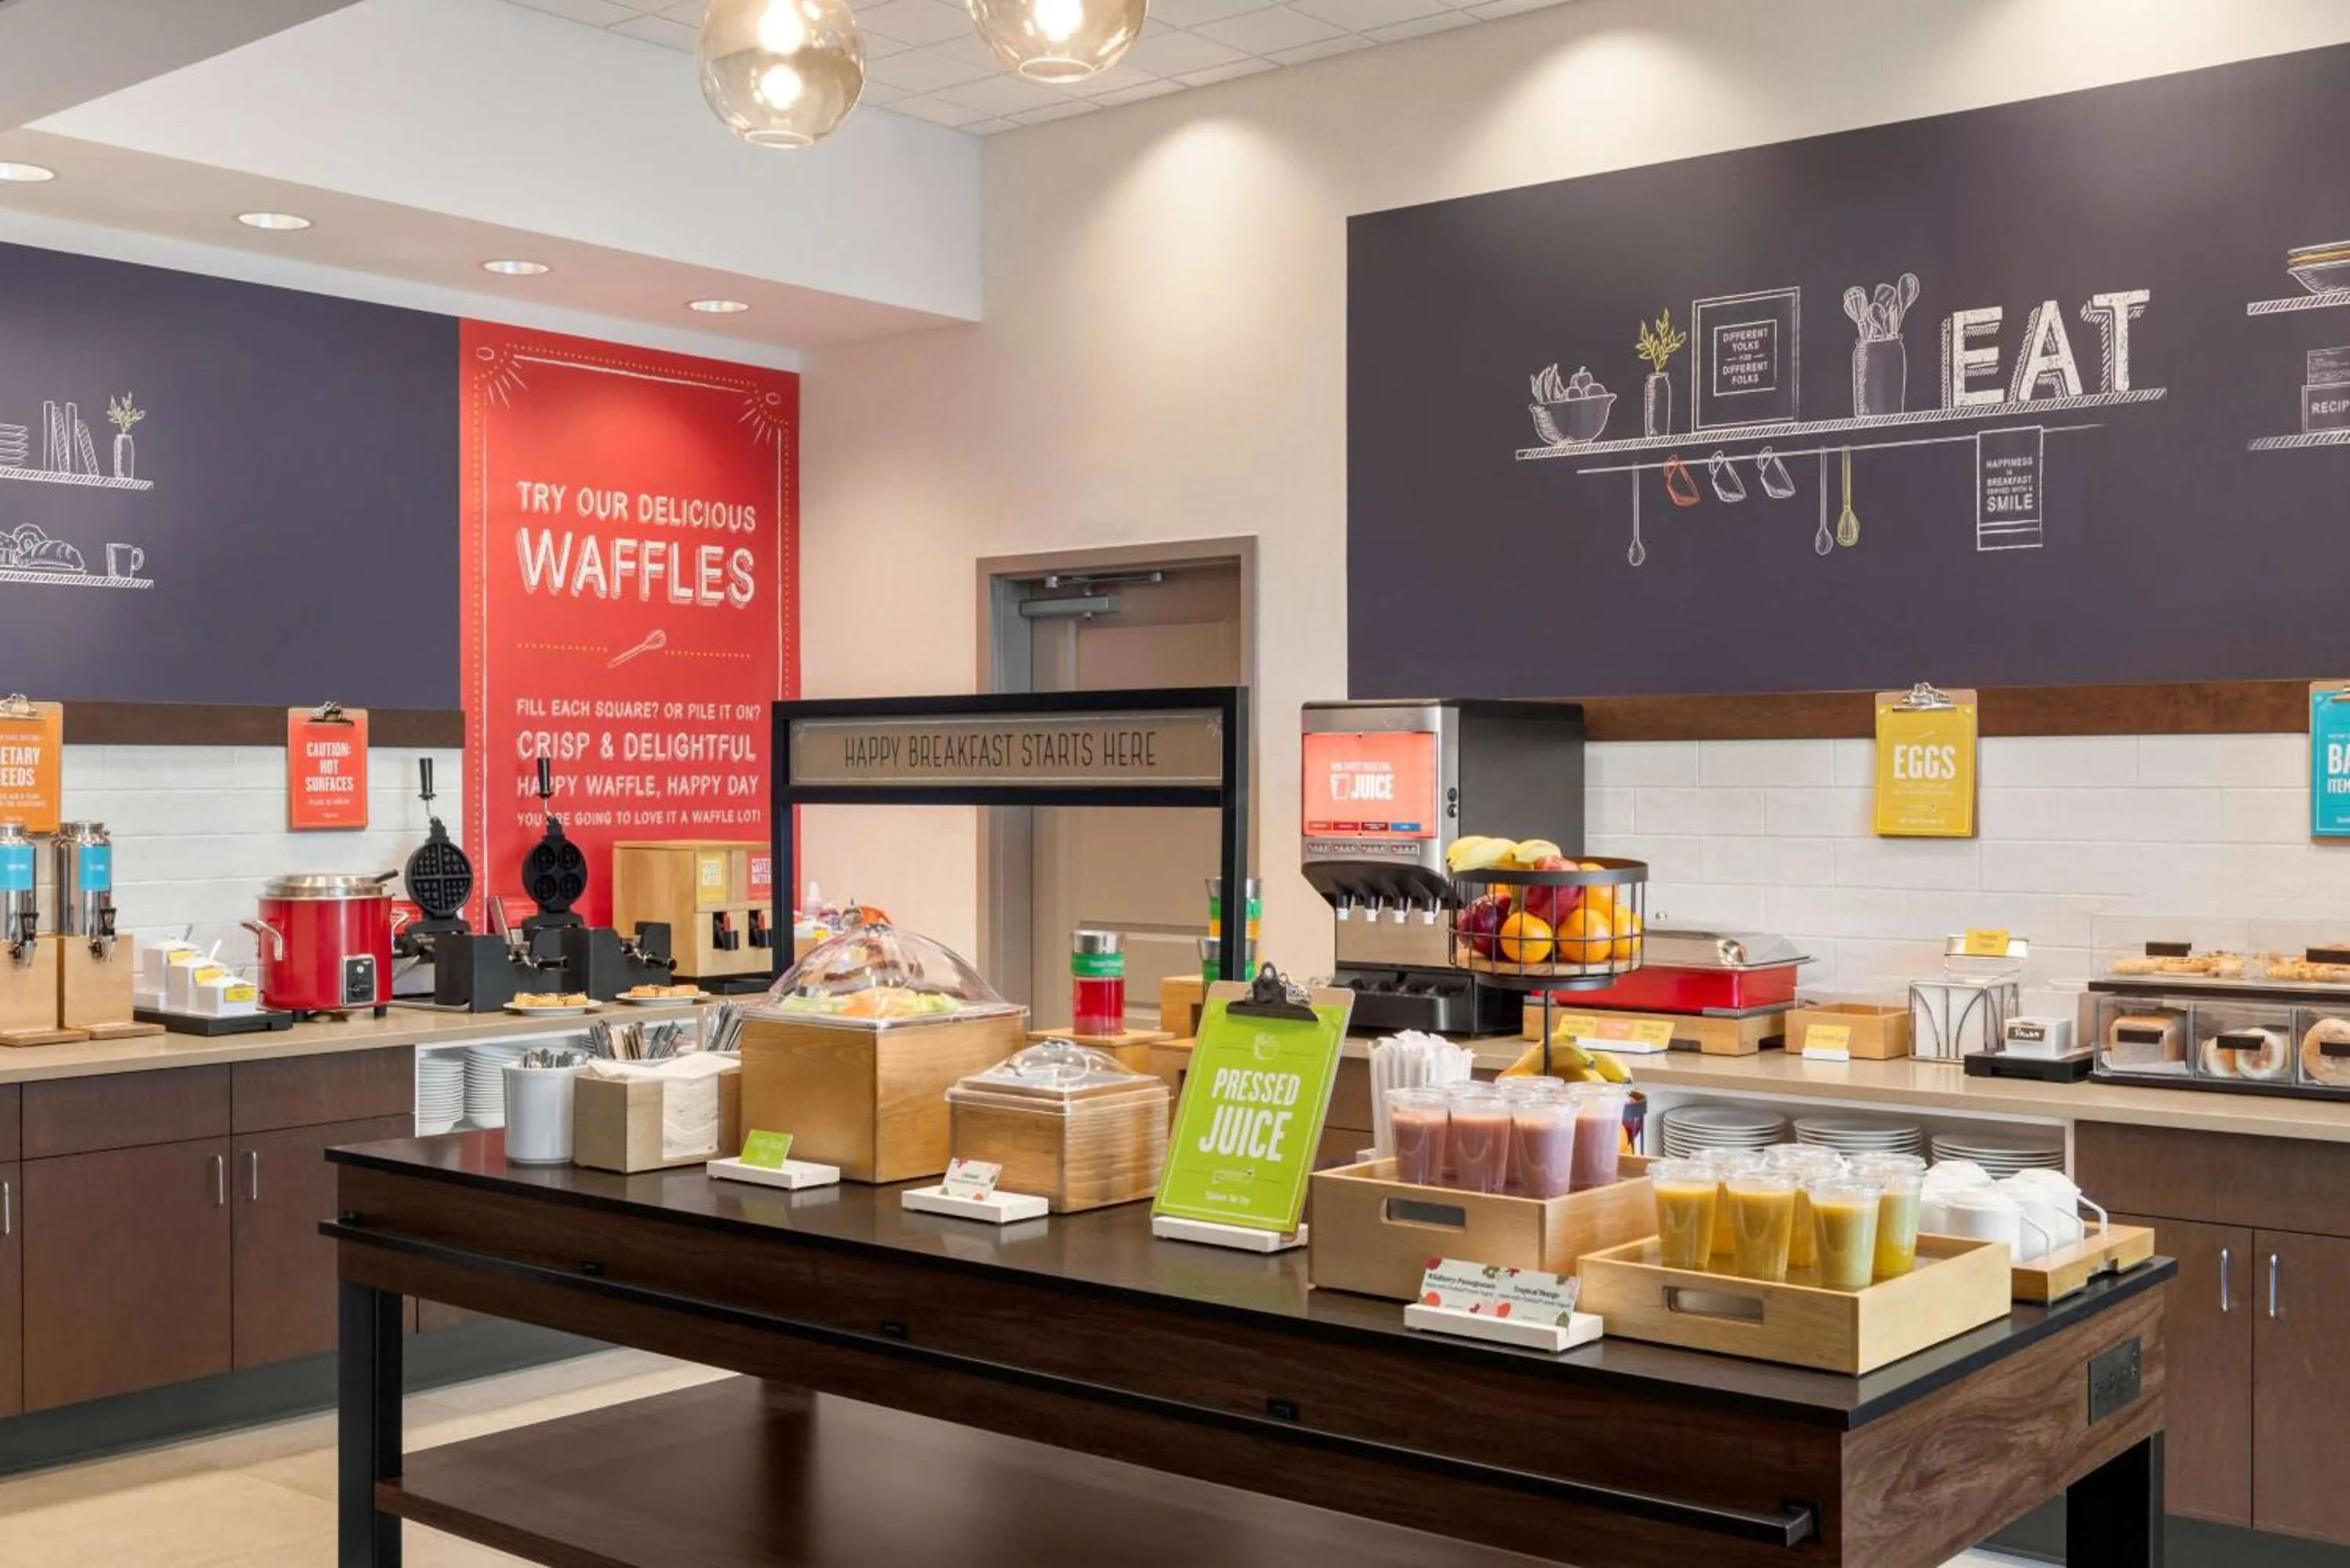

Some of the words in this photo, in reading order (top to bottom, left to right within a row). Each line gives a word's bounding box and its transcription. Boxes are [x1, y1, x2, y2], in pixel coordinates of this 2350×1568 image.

[1723, 327, 1768, 343] DIFFERENT
[1732, 339, 1759, 352] YOLKS
[1941, 289, 2150, 408] EAT
[1723, 361, 1768, 375] DIFFERENT
[1732, 374, 1759, 385] FOLKS
[1986, 457, 2033, 468] HAPPINESS
[1987, 475, 2032, 486] BREAKFAST
[515, 480, 566, 514] TRY
[577, 486, 628, 522] OUR
[638, 493, 757, 534] DELICIOUS
[1987, 493, 2033, 513] SMILE
[515, 526, 755, 609] WAFFLES
[516, 699, 546, 718] FILL
[551, 699, 590, 718] EACH
[595, 701, 659, 720] SQUARE?
[664, 702, 683, 720] OR
[689, 703, 715, 721] PILE
[719, 703, 731, 721] IT
[736, 704, 761, 721] ON?
[516, 730, 590, 762] CRISP
[600, 731, 615, 762] &
[623, 732, 757, 763] DELIGHTFUL
[844, 735, 901, 768] HAPPY
[909, 734, 1014, 767] BREAKFAST
[1021, 732, 1094, 767] STARTS
[1104, 731, 1157, 767] HERE
[320, 759, 339, 775] HOT
[1893, 744, 1956, 779] EGGS
[305, 776, 354, 793] SURFACES
[517, 775, 579, 797] HAPY
[585, 775, 661, 799] WAFFLE,
[667, 775, 722, 797] HAPPY
[727, 775, 760, 796] DAY
[1351, 772, 1395, 800] JUICE
[517, 811, 543, 827] YOU
[575, 811, 612, 826] GOING
[616, 810, 631, 825] TO
[635, 810, 663, 825] LOVE
[666, 810, 677, 824] IT
[680, 810, 689, 824] A
[692, 809, 734, 823] WAFFLE
[737, 808, 761, 822] LOT!
[1212, 1066, 1301, 1107] PRESSED
[1198, 1104, 1293, 1162] JUICE
